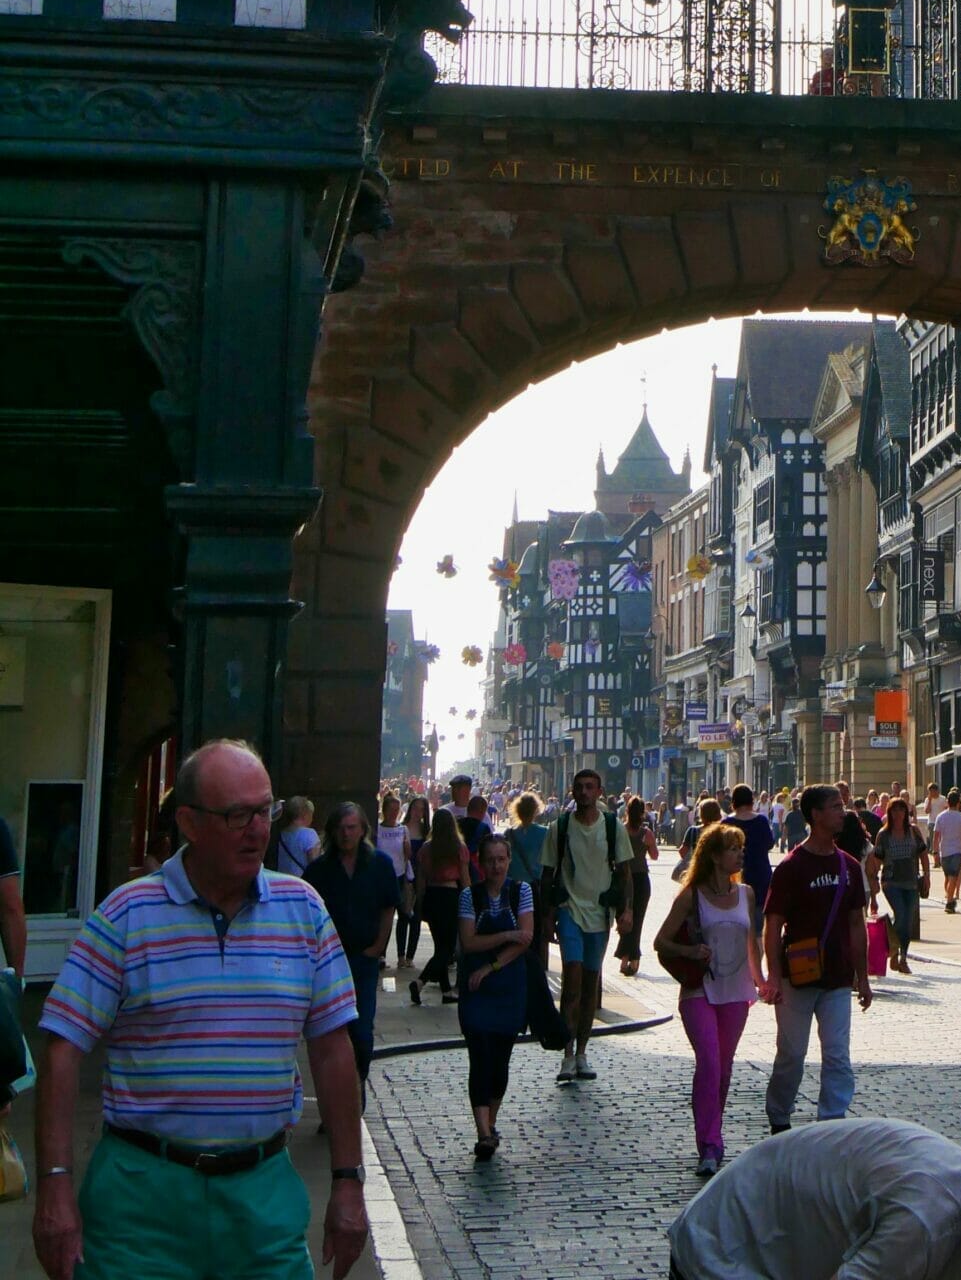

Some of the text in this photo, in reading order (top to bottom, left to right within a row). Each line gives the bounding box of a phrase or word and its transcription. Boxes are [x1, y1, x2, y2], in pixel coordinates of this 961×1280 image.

[488, 159, 522, 178] AT
[554, 161, 600, 182] THE
[633, 165, 736, 187] EXPENCE
[923, 557, 936, 597] next
